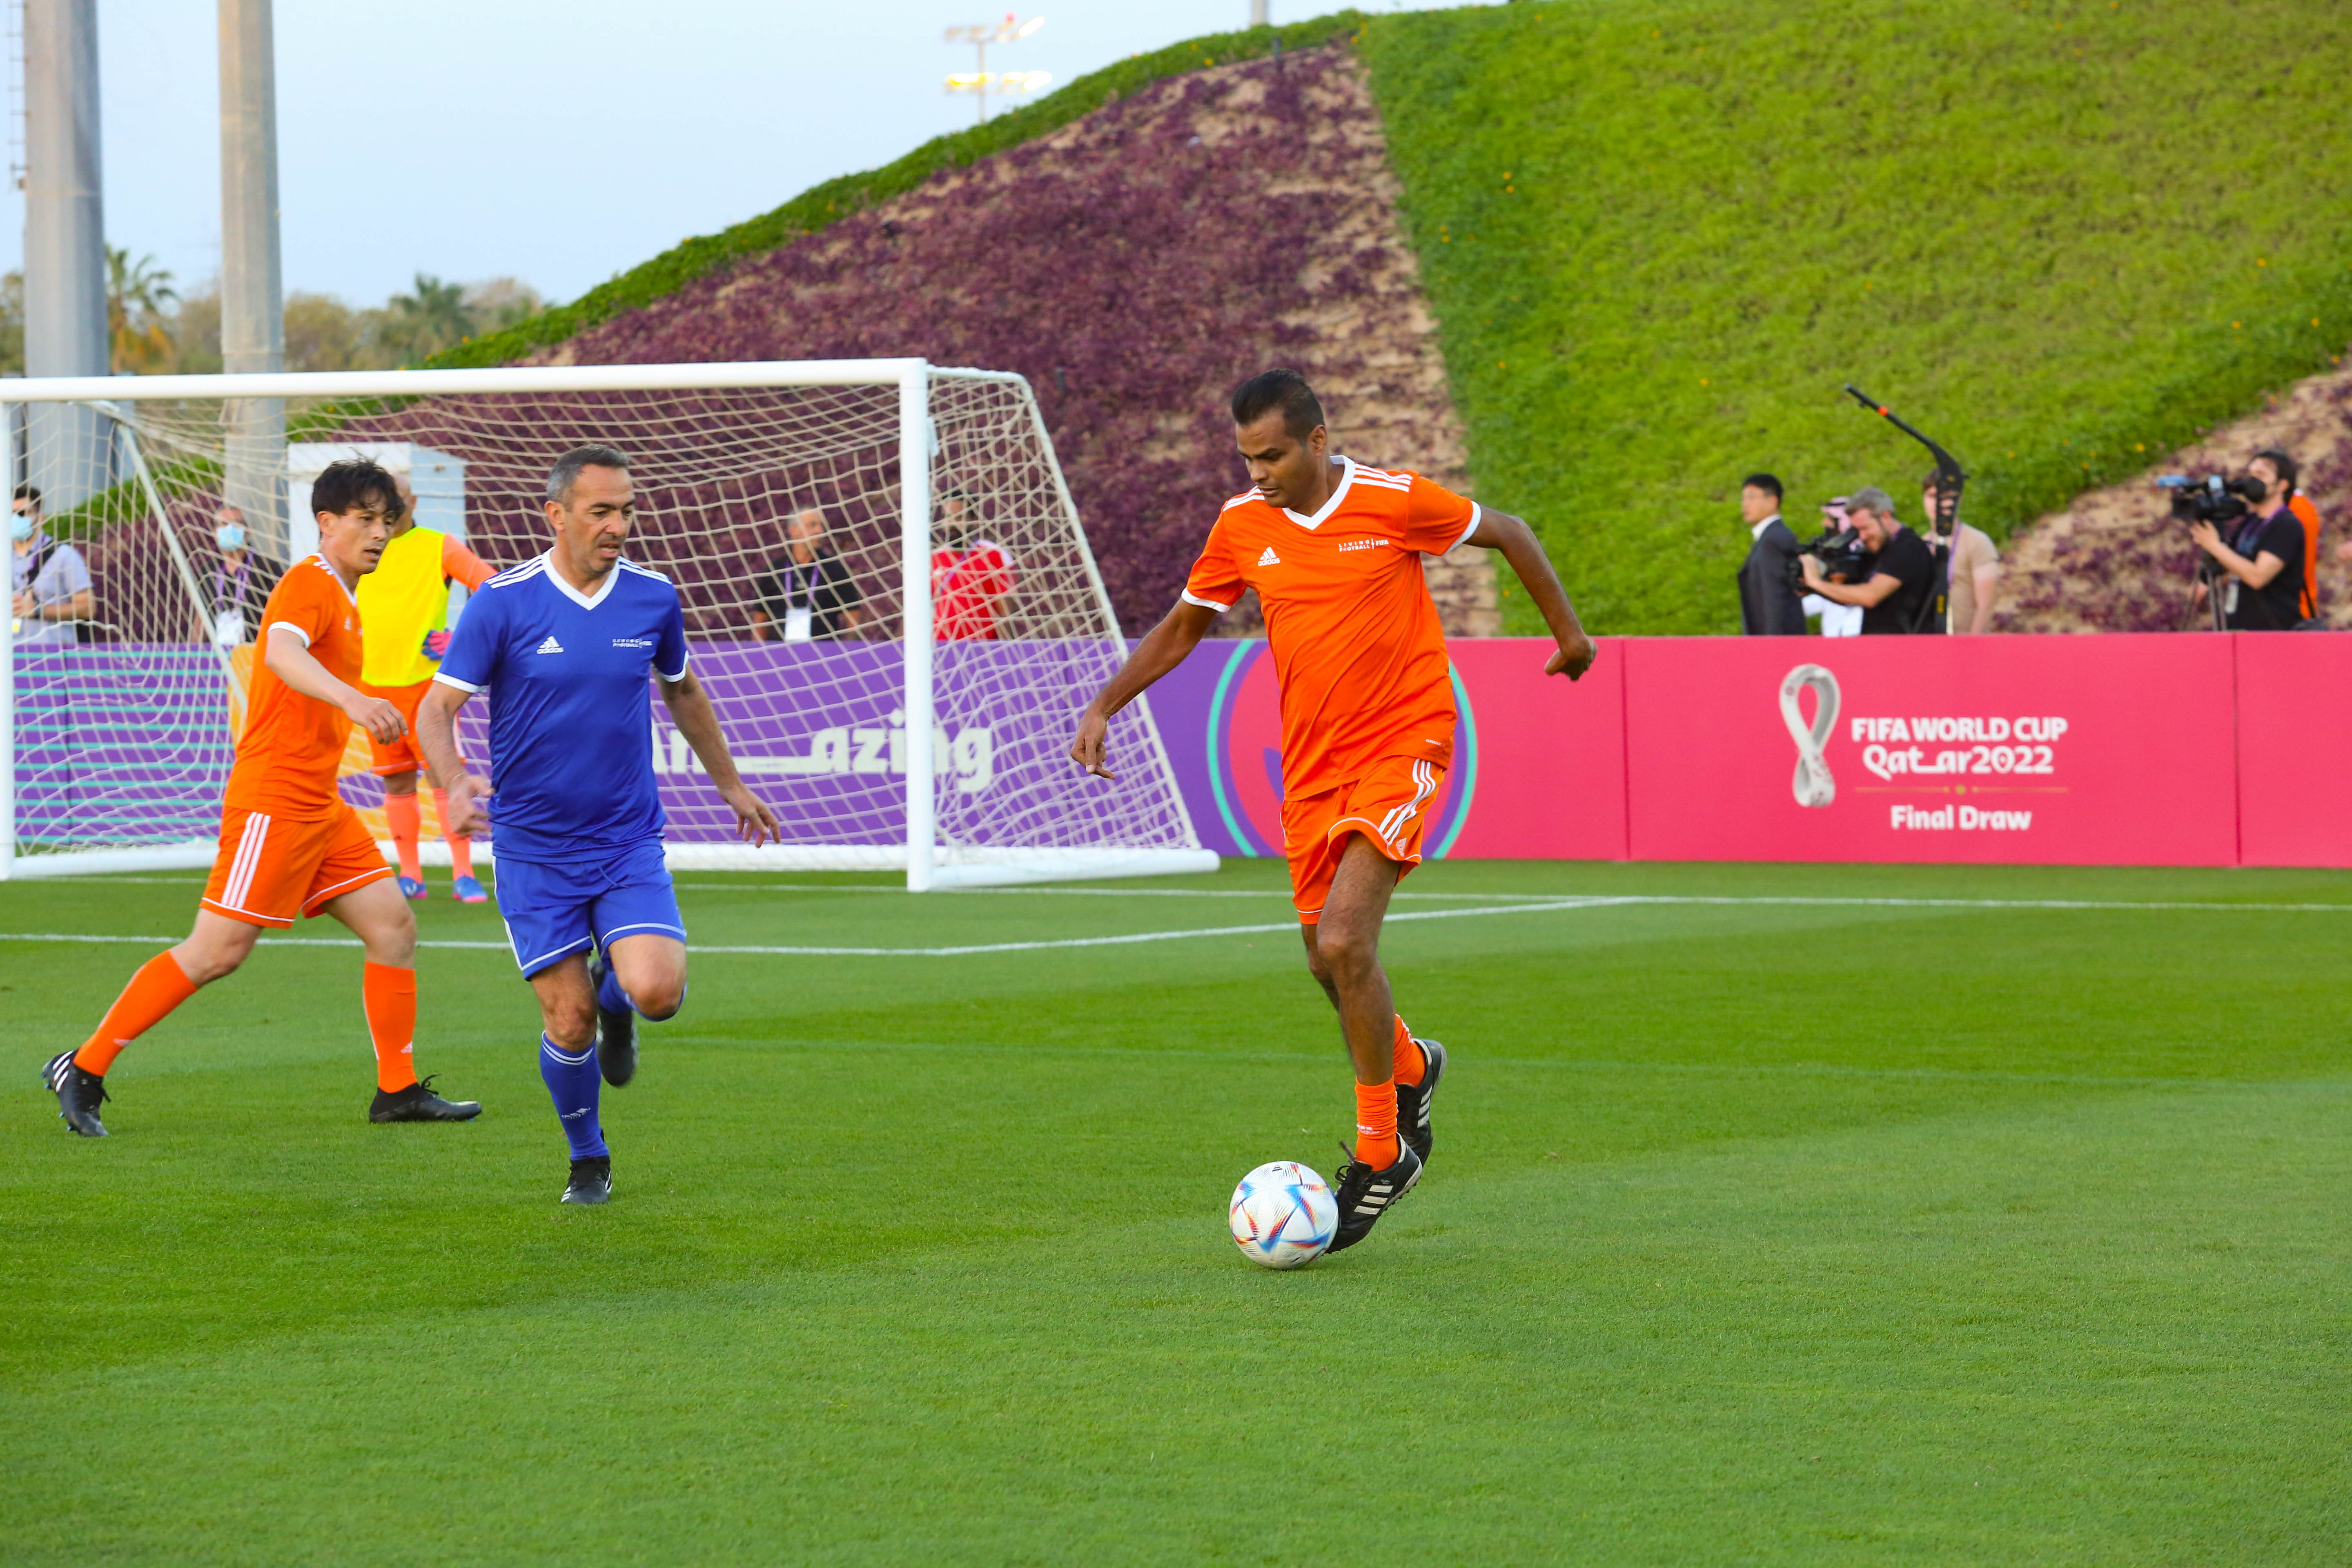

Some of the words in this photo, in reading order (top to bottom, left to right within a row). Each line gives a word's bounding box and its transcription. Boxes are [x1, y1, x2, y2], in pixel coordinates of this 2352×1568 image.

[1851, 717, 1911, 742] FIFA
[1911, 717, 2010, 742] WORLD
[2013, 717, 2068, 742] CUP
[1891, 805, 1954, 830] Final
[1959, 806, 2031, 830] Draw
